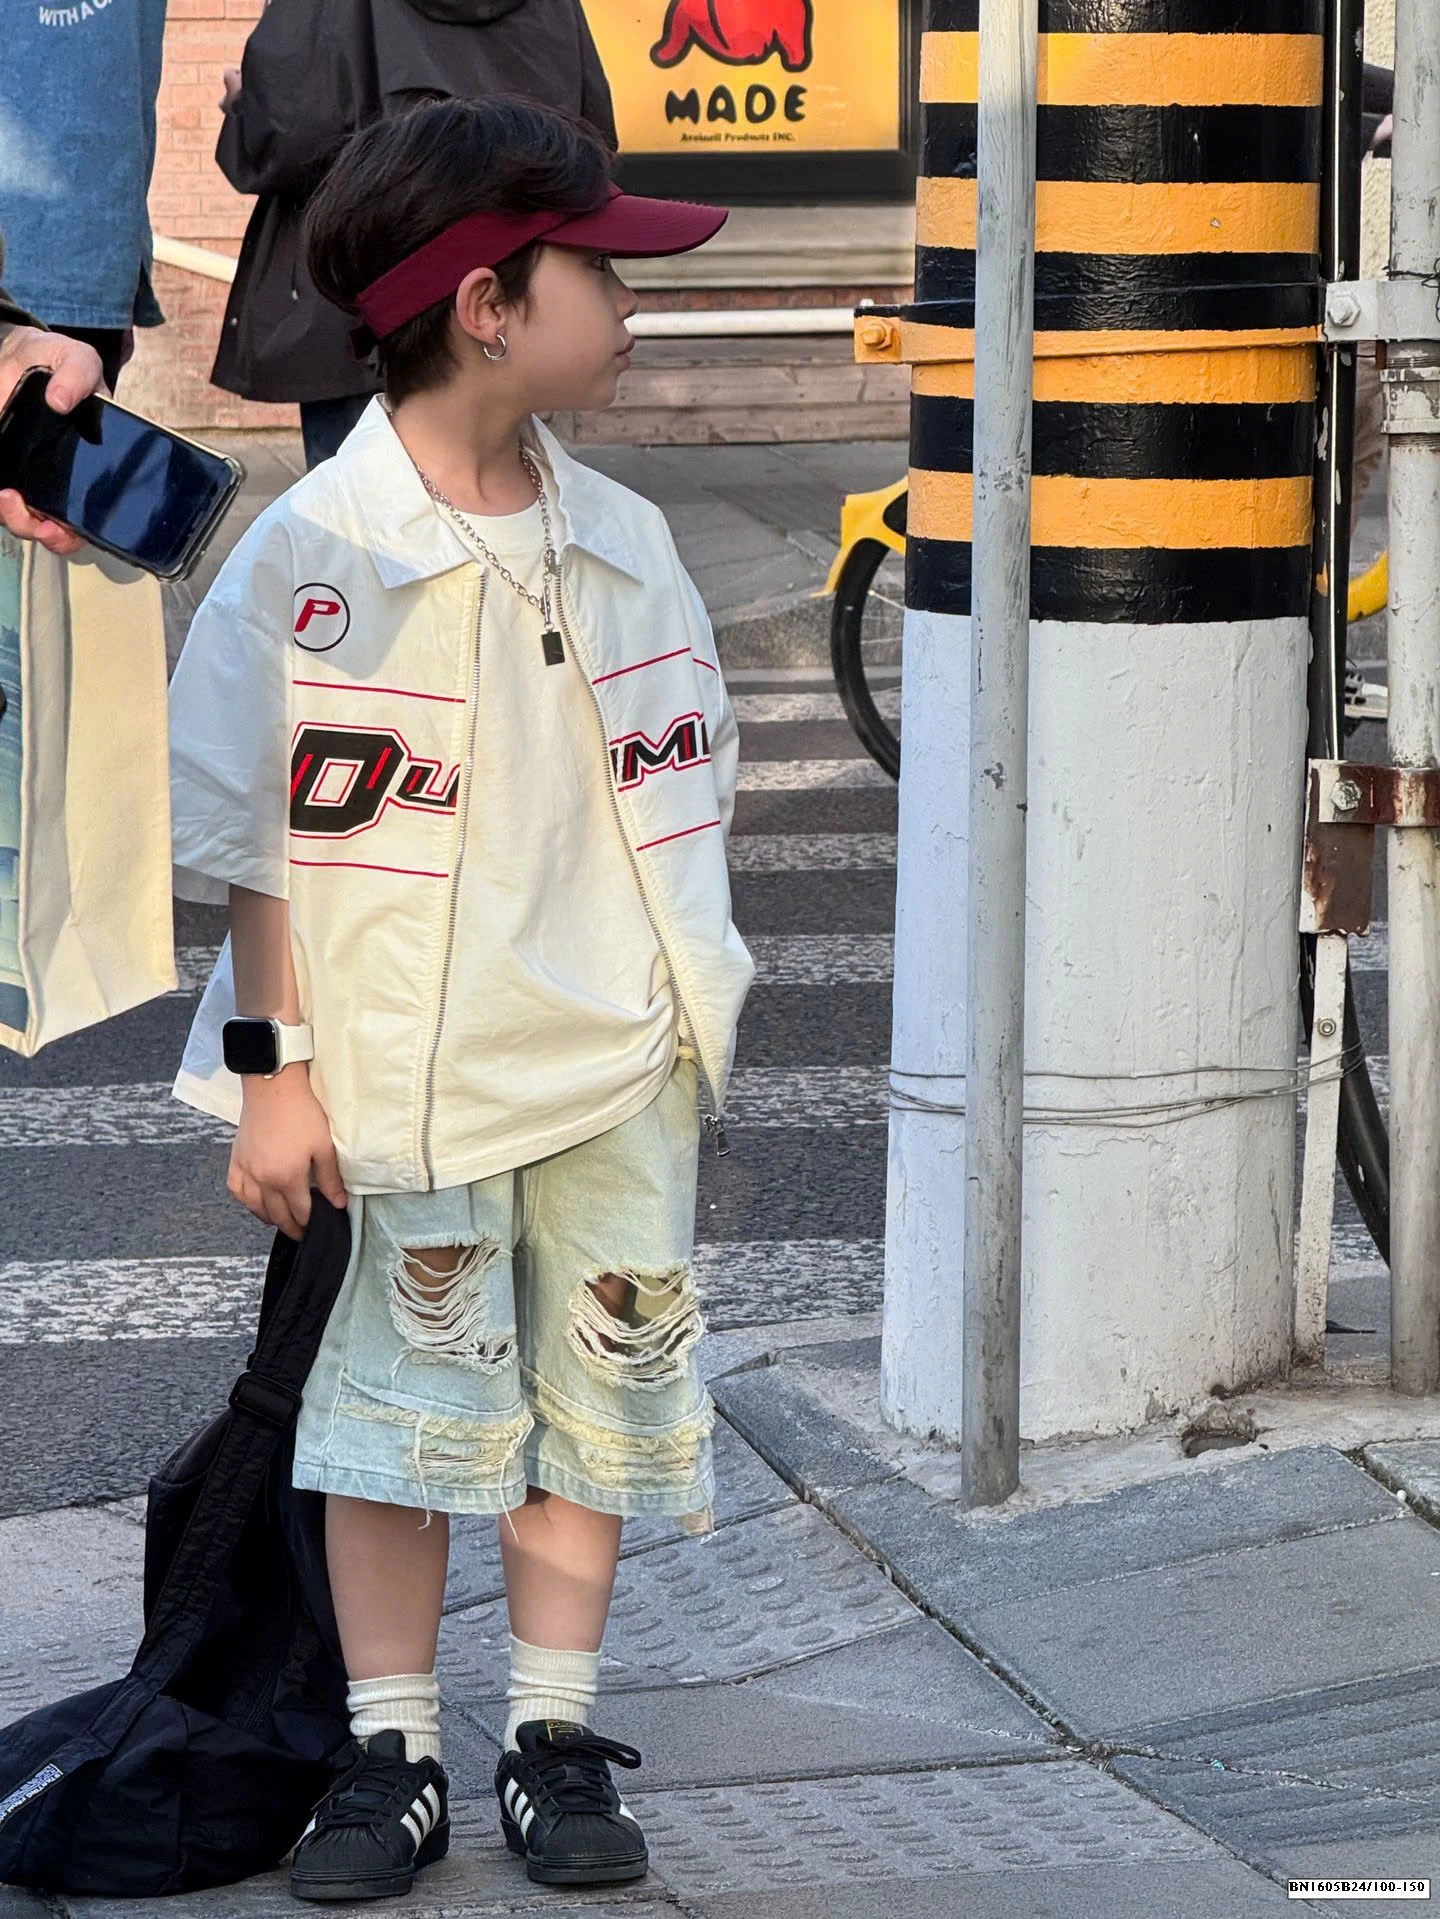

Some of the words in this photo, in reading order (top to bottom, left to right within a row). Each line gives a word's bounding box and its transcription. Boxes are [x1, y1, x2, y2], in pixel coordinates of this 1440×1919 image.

[39, 6, 80, 27] WITH
[81, 1, 95, 20] A
[665, 84, 808, 125] MADE
[294, 598, 342, 633] P
